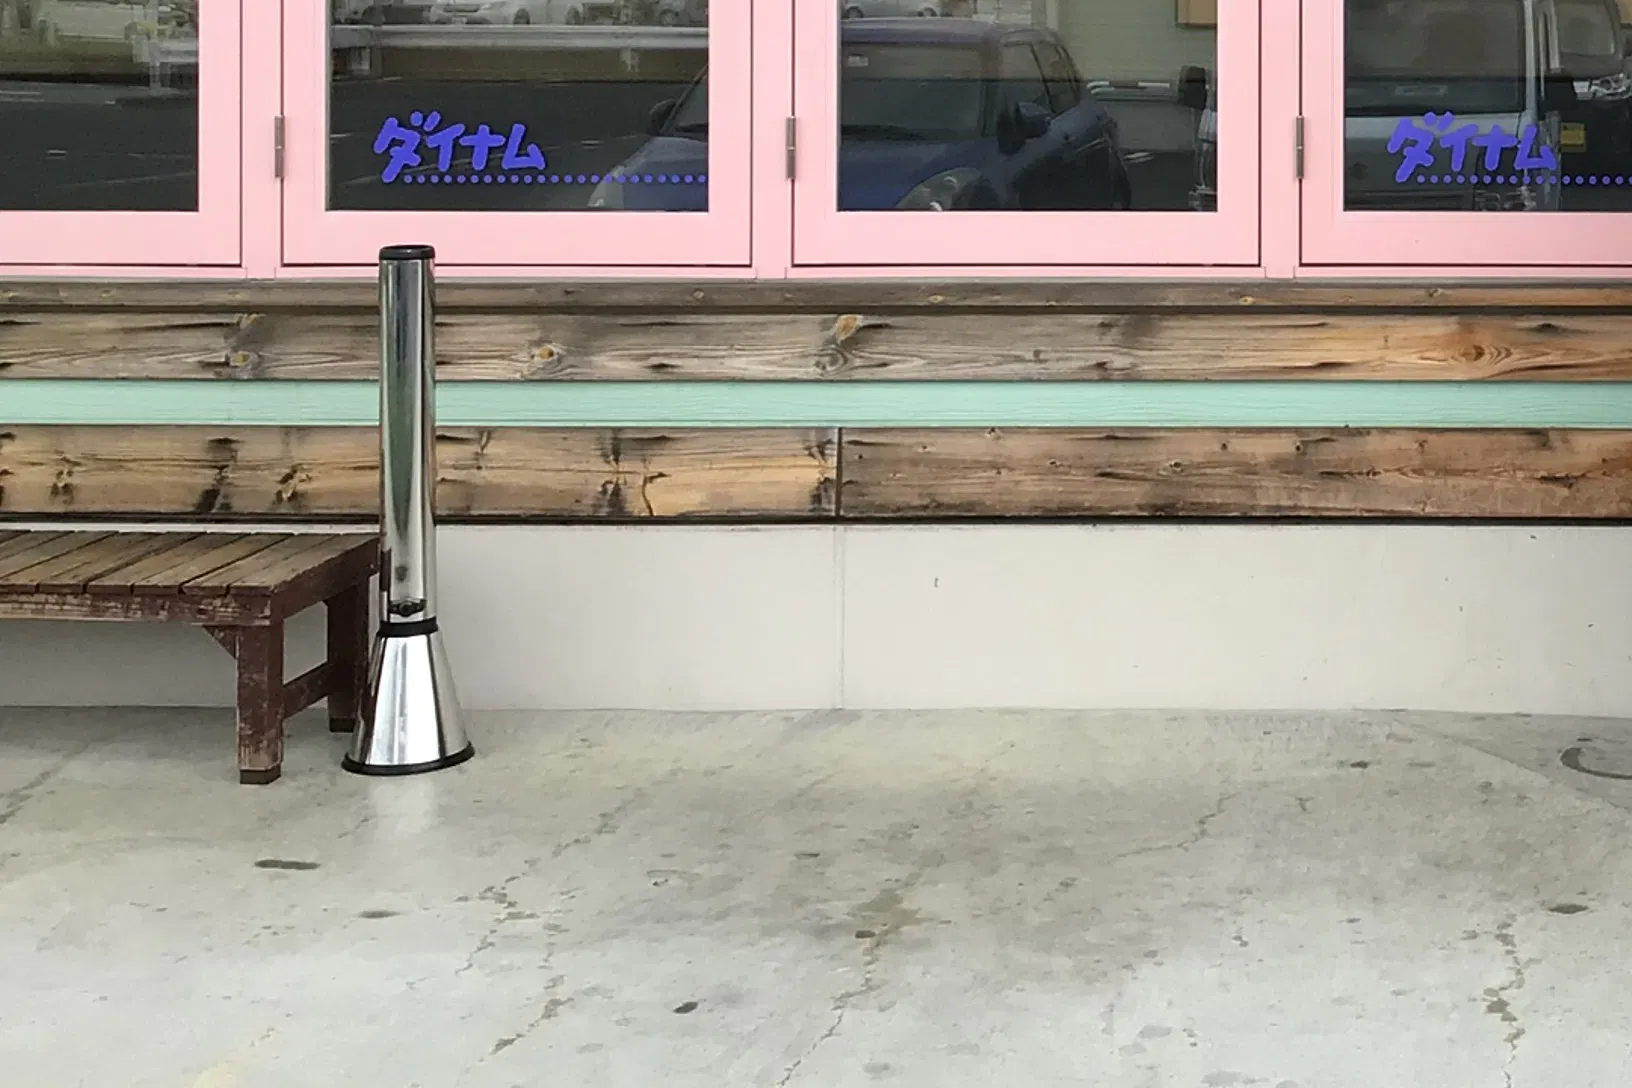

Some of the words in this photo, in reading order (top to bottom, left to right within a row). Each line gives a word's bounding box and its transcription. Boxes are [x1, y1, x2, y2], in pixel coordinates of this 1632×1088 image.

[373, 111, 546, 184] ダイナム
[1386, 111, 1557, 183] ダイナム
